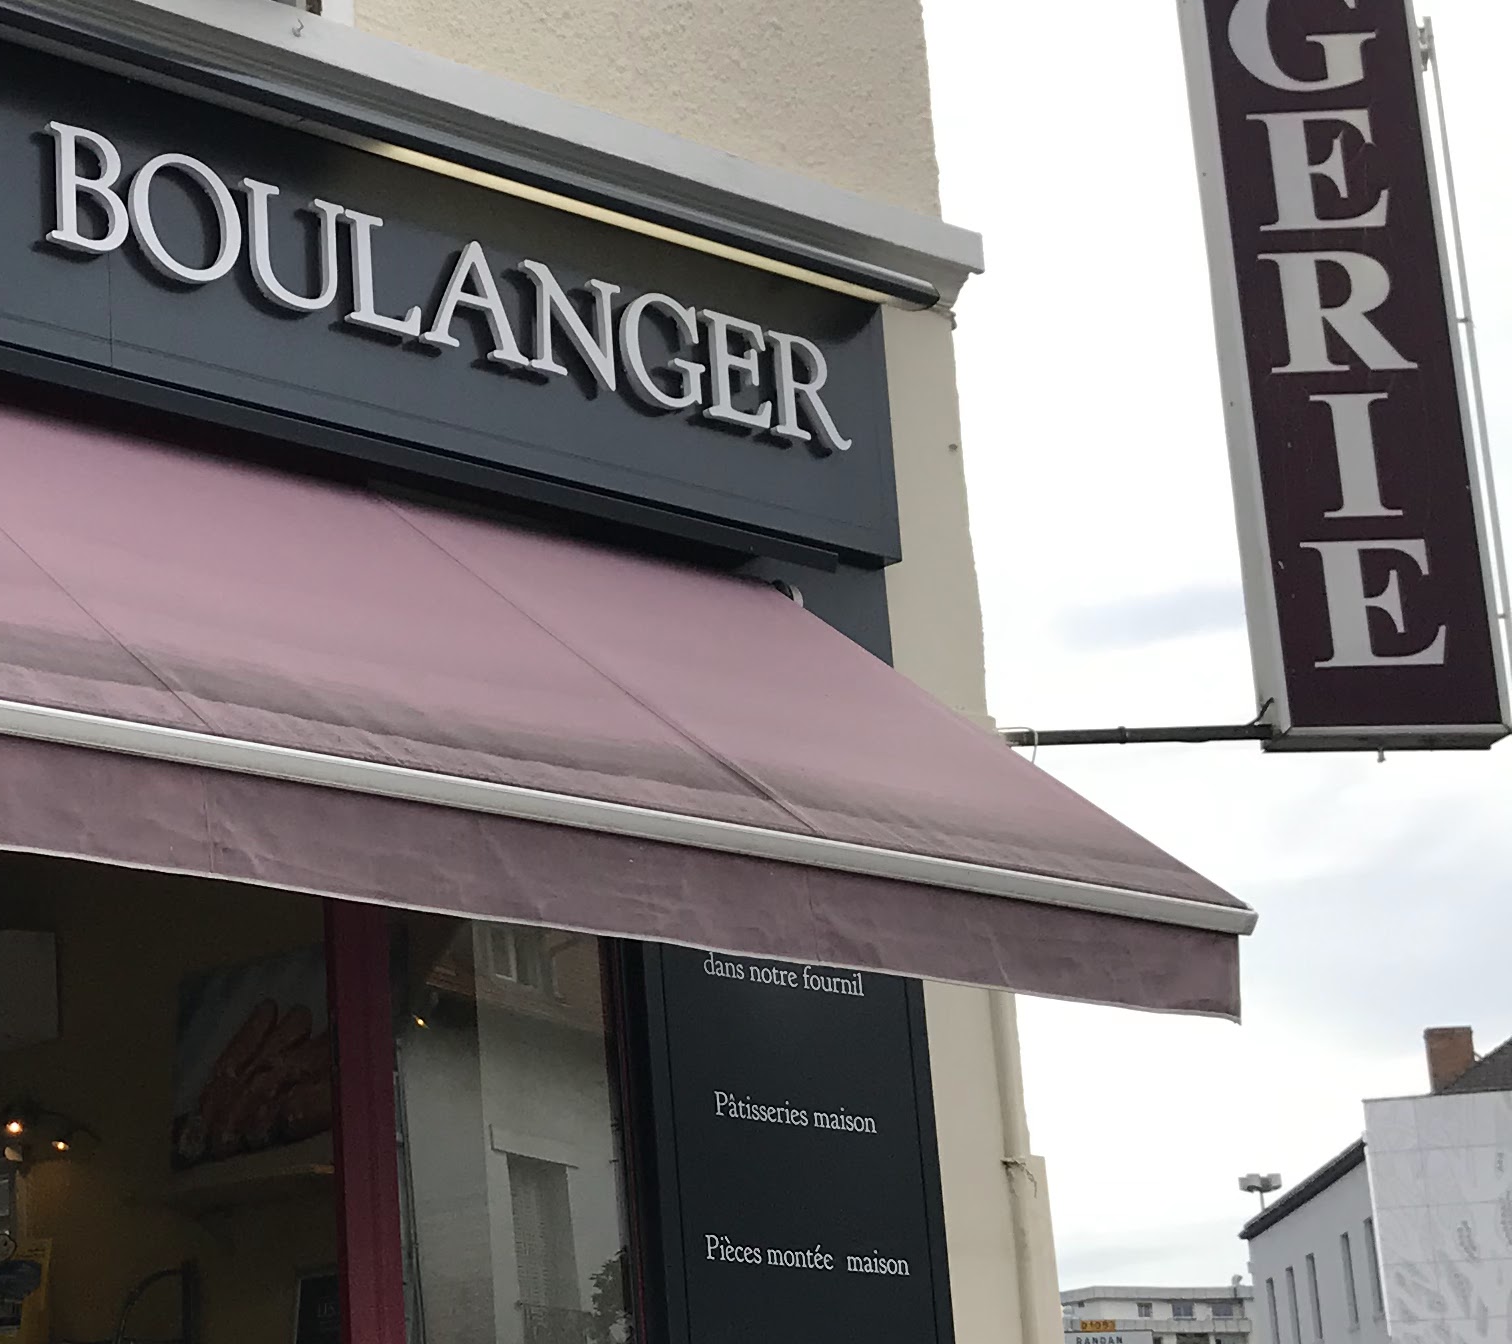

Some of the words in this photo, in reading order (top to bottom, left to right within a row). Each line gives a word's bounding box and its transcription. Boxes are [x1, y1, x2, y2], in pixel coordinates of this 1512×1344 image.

[44, 121, 852, 451] BOULANGER
[703, 952, 745, 980] dans
[749, 965, 799, 988] notre
[803, 965, 865, 997] fournil
[714, 1090, 809, 1127] Pâtisseries
[813, 1107, 877, 1134] maison
[704, 1234, 763, 1265] Pièces
[767, 1244, 834, 1271] montée
[846, 1249, 910, 1276] maison
